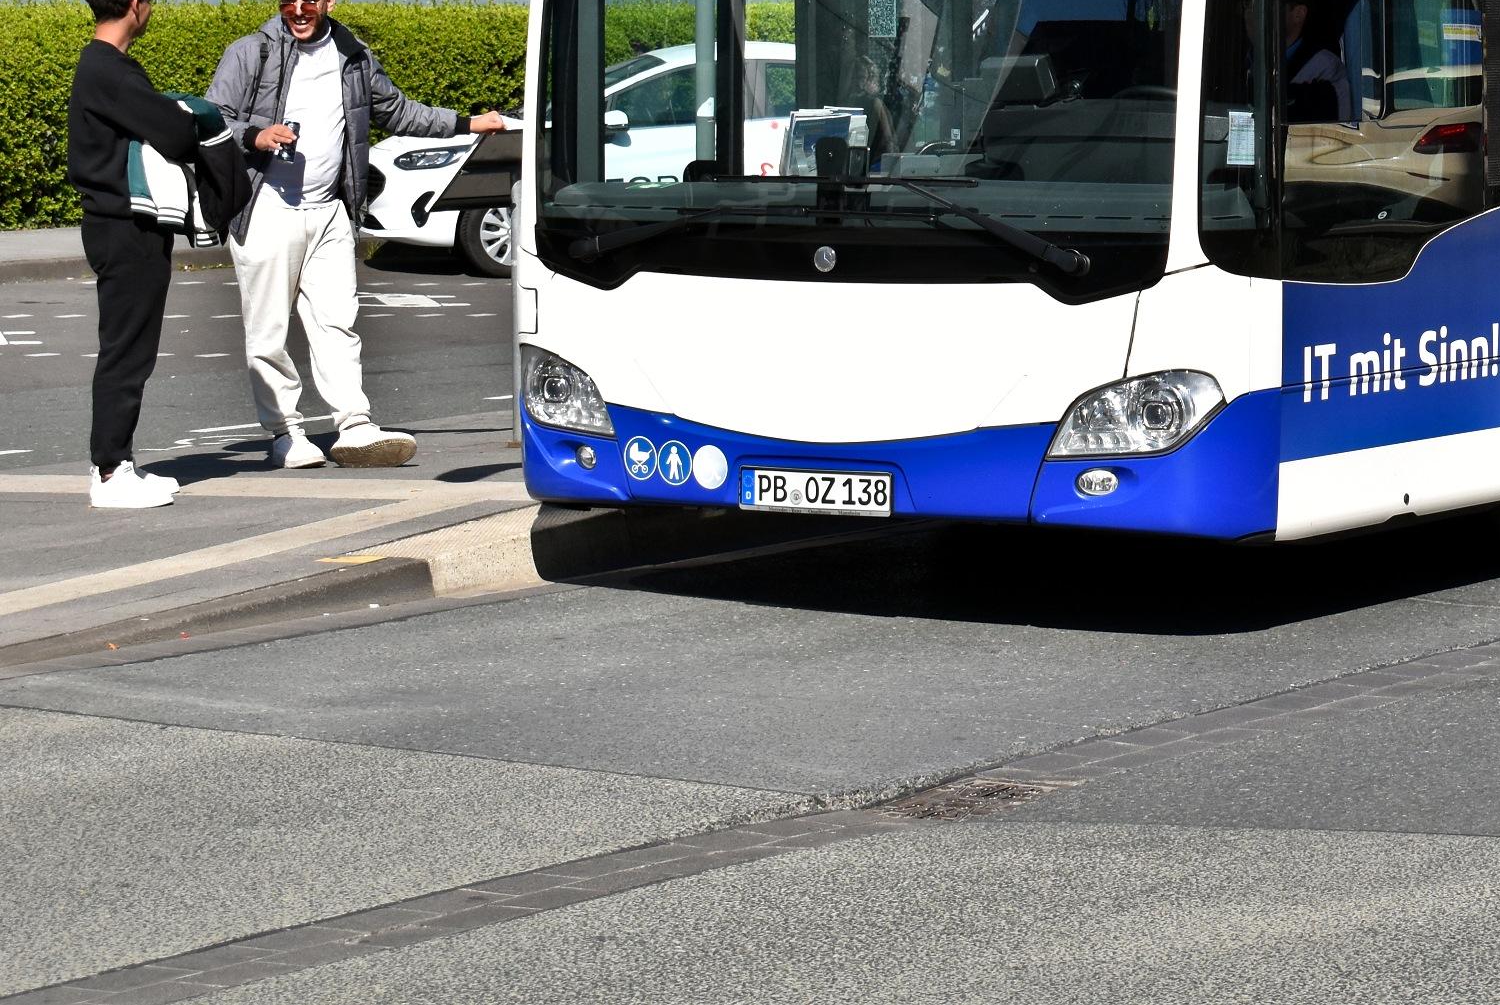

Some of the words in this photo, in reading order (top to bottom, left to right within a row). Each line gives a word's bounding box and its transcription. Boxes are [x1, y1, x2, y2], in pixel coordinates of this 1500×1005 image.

[1303, 343, 1337, 403] IT
[1350, 332, 1406, 396] mit
[1418, 322, 1500, 387] Sinn!
[757, 474, 788, 503] PB
[805, 476, 836, 504] OZ
[841, 477, 888, 507] 138
